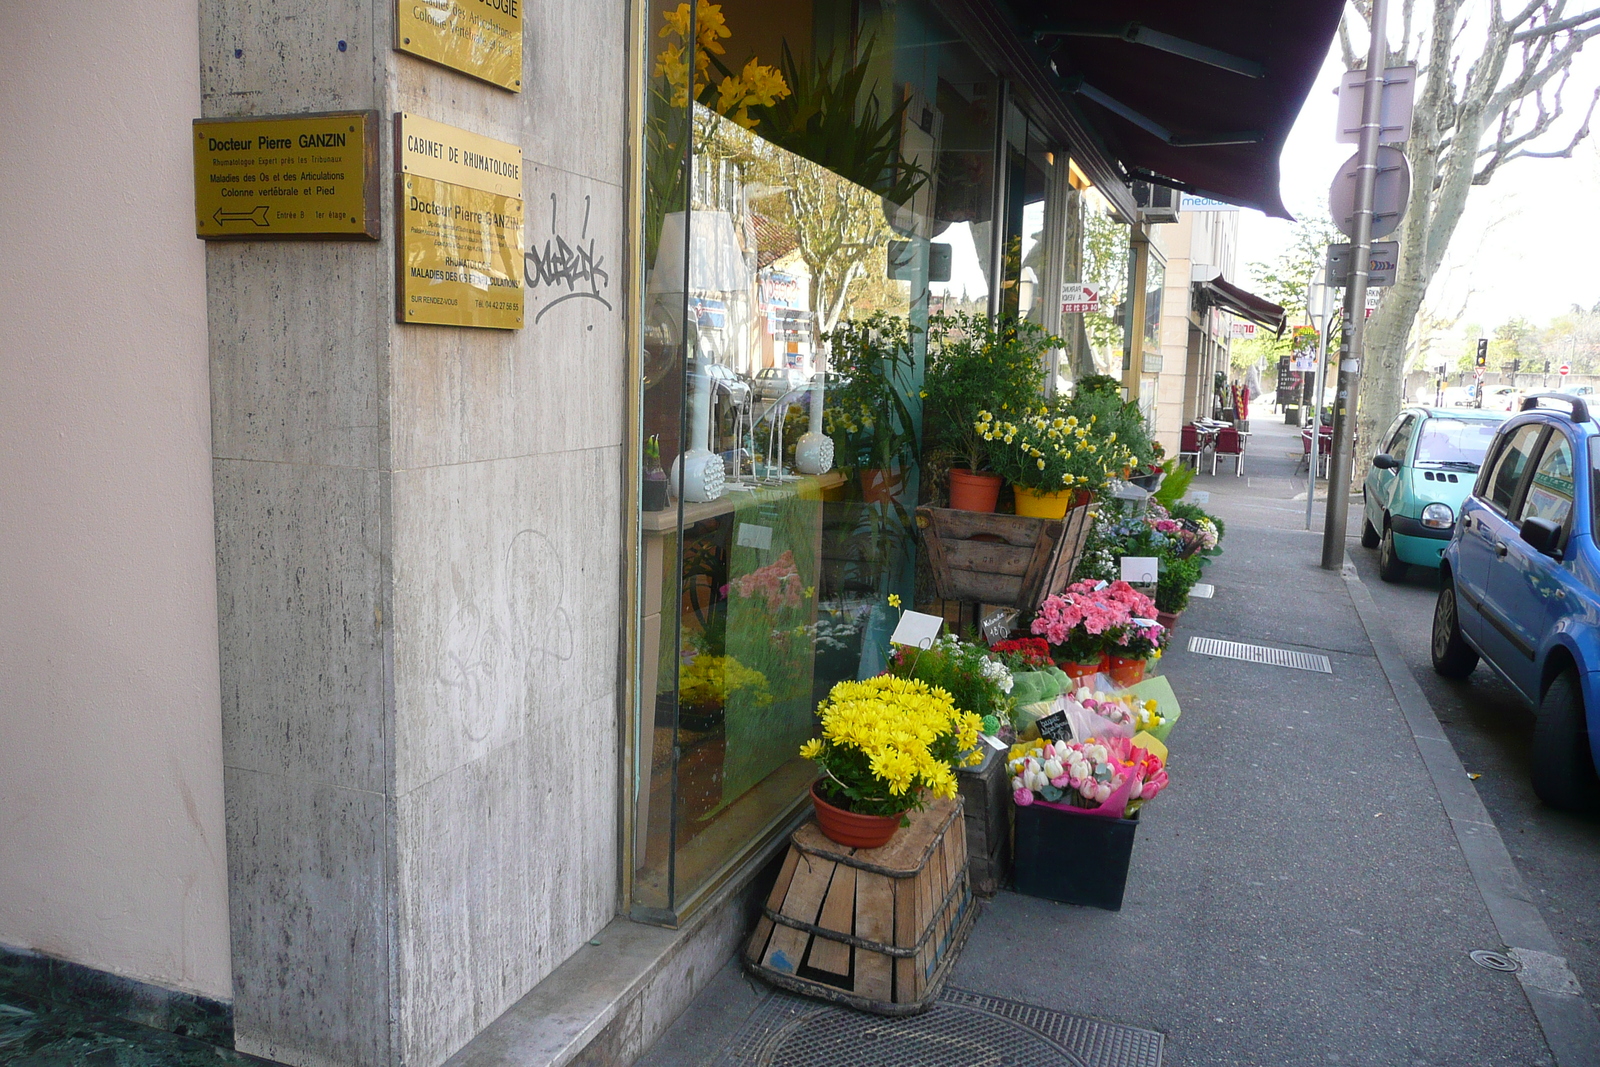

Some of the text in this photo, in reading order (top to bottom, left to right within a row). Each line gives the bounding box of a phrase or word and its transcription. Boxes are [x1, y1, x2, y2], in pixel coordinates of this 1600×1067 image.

[413, 5, 447, 30] Colonne
[452, 5, 466, 20] des
[208, 132, 346, 152] Docteur Pierre GANZIN
[212, 155, 343, 167] Rhumatologue Expert près les Tribunaux
[407, 134, 519, 180] CABINET DE RHUMATOLOGIE
[209, 170, 345, 183] Maladies des Os et des Articulations
[221, 185, 335, 198] Colonne vertébrale et Pied
[276, 210, 347, 220] Entrée B 1er étage
[410, 195, 452, 218] Docteur
[455, 205, 482, 223] Pierre
[485, 211, 519, 231] GANZIN
[410, 266, 444, 281] MALADIES
[445, 271, 458, 283] DES
[411, 294, 458, 307] SUR RENDEZ-VOUS
